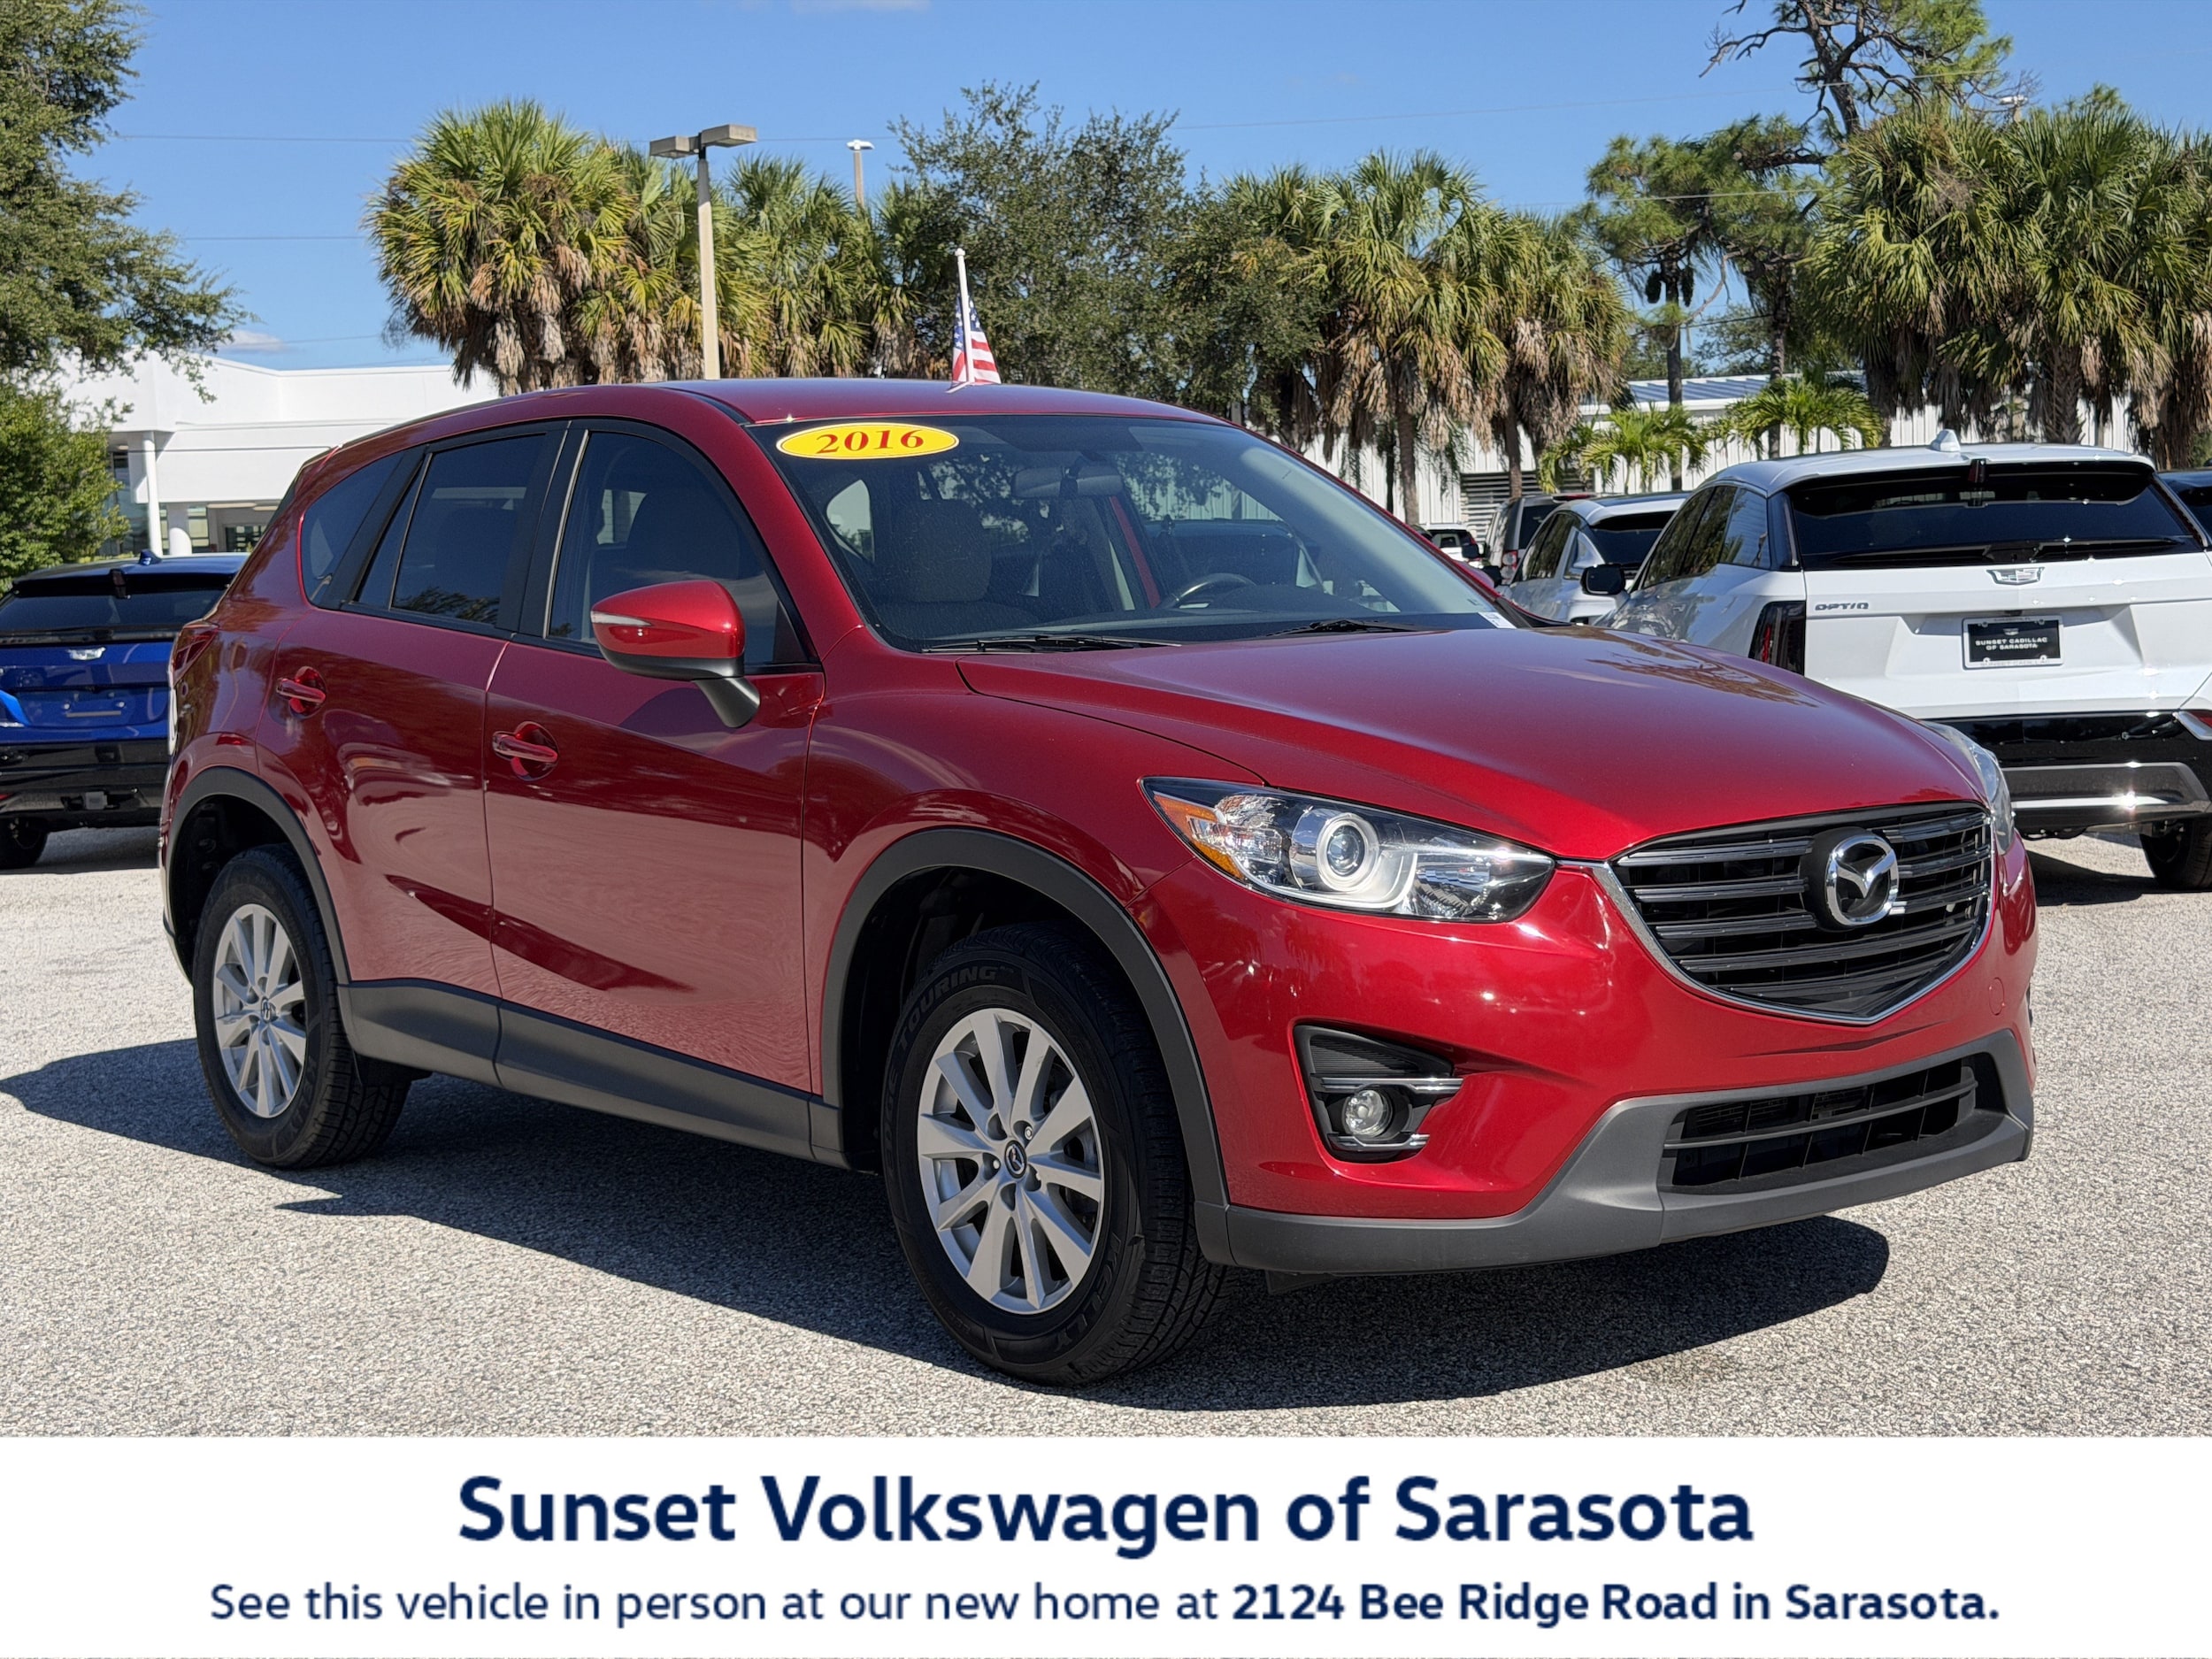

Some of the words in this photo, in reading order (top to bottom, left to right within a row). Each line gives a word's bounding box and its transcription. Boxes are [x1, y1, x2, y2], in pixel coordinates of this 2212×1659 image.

[815, 429, 925, 454] 2016
[896, 965, 996, 1050] TOURING
[289, 1055, 317, 1138] KELLY
[1053, 1232, 1121, 1353] KELLY
